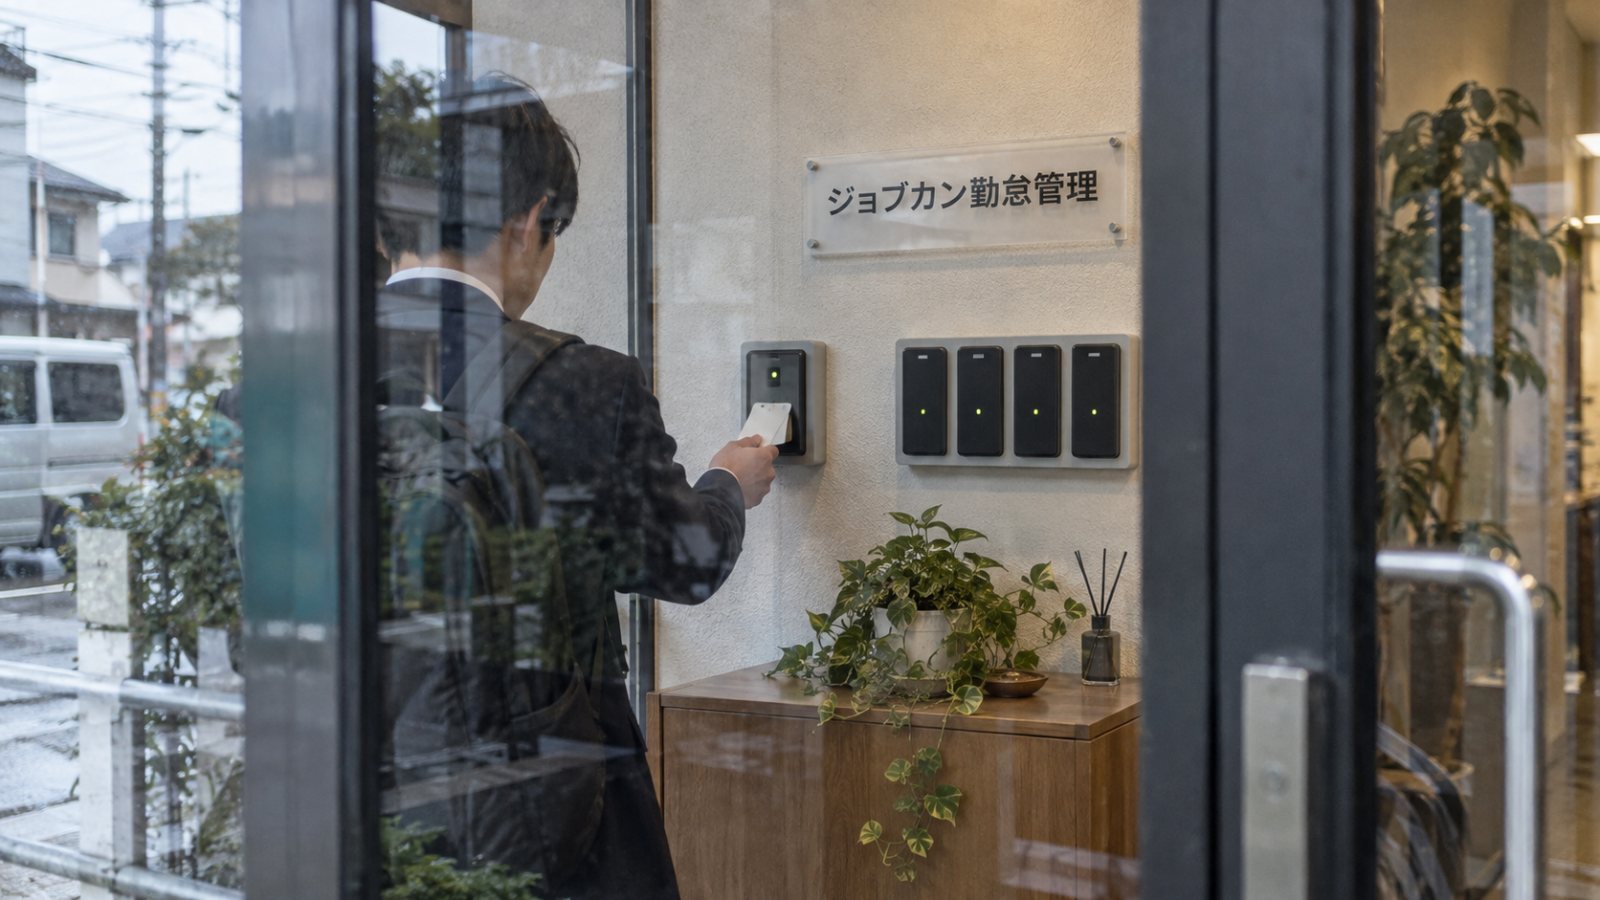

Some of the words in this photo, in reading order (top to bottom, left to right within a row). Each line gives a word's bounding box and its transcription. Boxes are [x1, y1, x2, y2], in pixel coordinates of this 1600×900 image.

[828, 170, 1098, 215] ジョブカン勤怠管理
